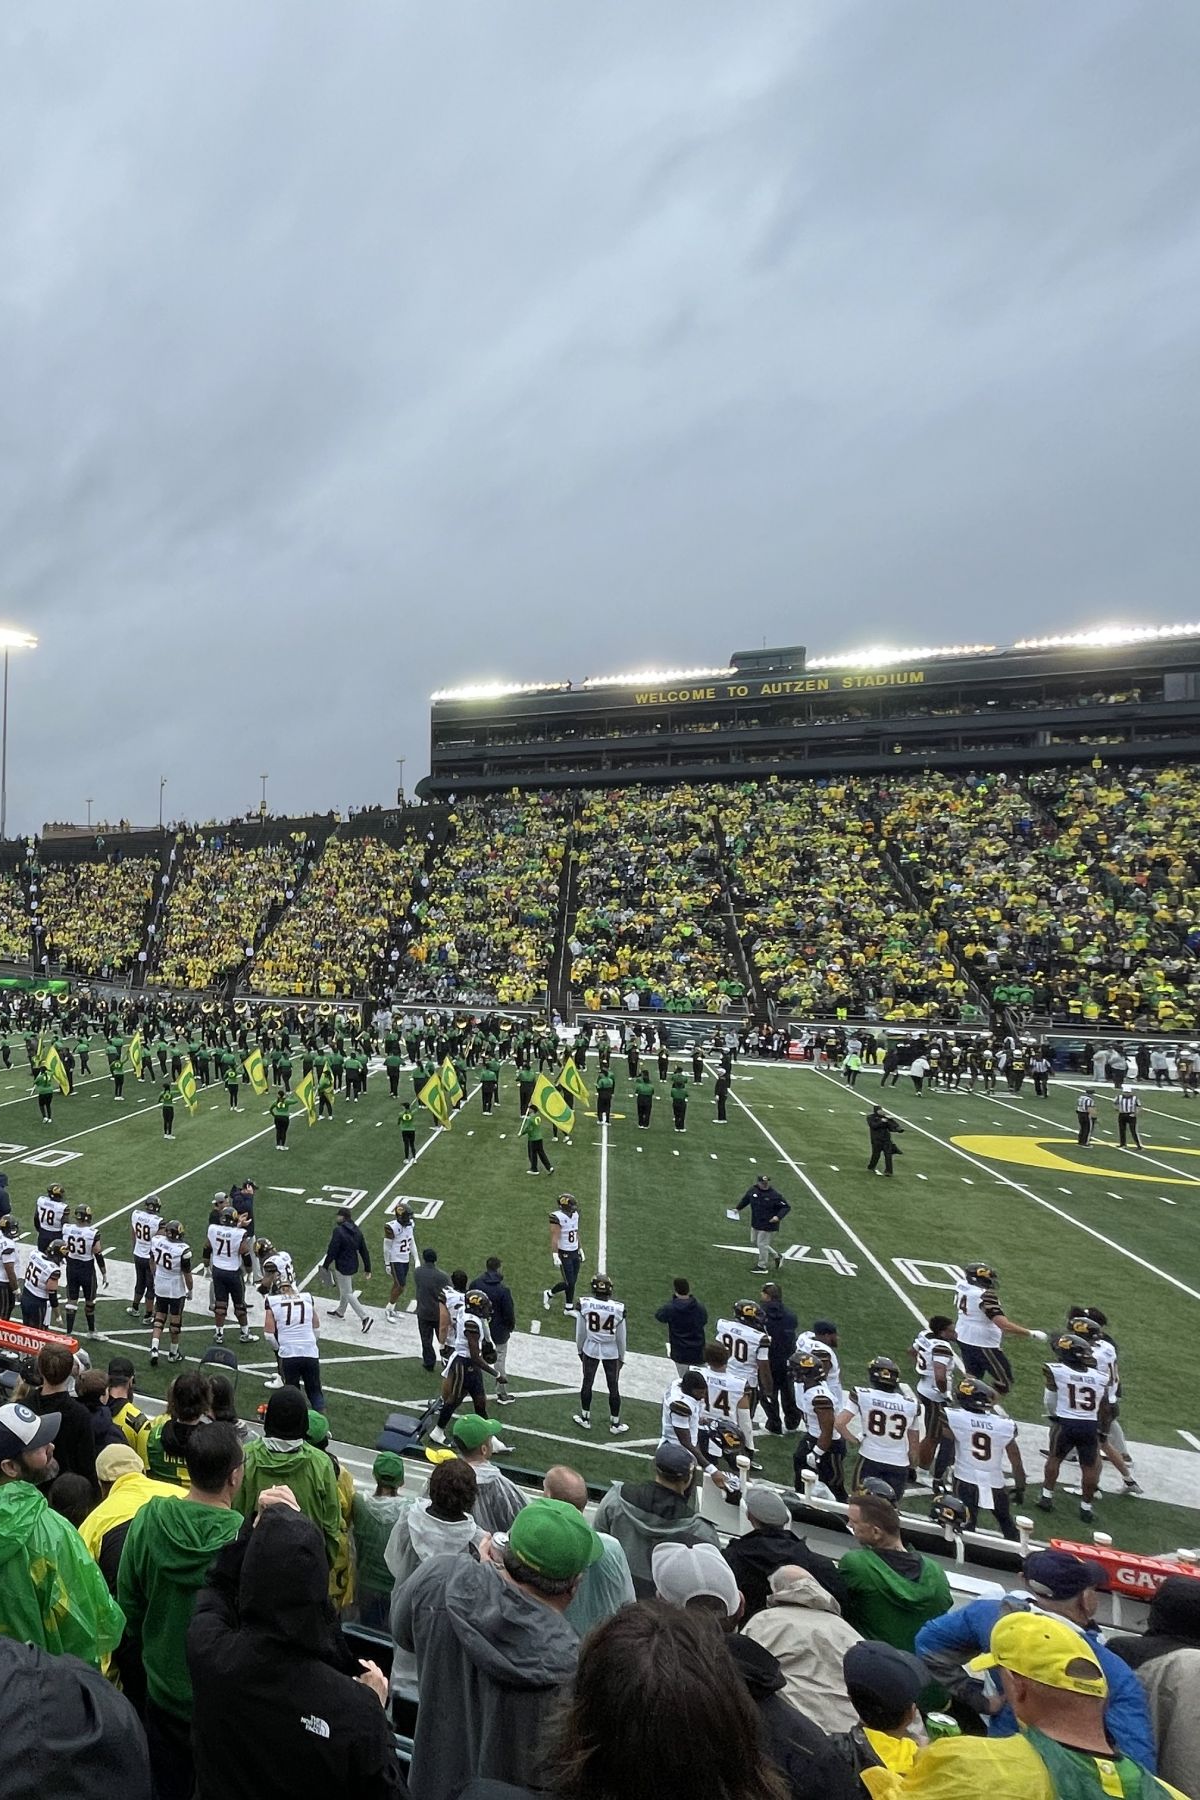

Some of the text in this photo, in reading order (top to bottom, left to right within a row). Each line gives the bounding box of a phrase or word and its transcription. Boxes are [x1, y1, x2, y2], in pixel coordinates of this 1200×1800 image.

[635, 671, 924, 704] WELCOME TO AUTZEN STADIUM
[40, 1207, 54, 1225] 78
[135, 1222, 150, 1242] 68
[67, 1236, 87, 1256] 63
[216, 1237, 232, 1258] 71
[154, 1248, 173, 1270] 76
[25, 1261, 42, 1287] 65
[280, 1301, 305, 1325] 77
[588, 1311, 615, 1334] 84
[723, 1334, 748, 1363] 90
[872, 1398, 904, 1412] GRIZZELL
[1067, 1383, 1096, 1411] 13
[868, 1408, 907, 1440] 83
[970, 1418, 993, 1431] DAVIS
[972, 1431, 991, 1462] 9
